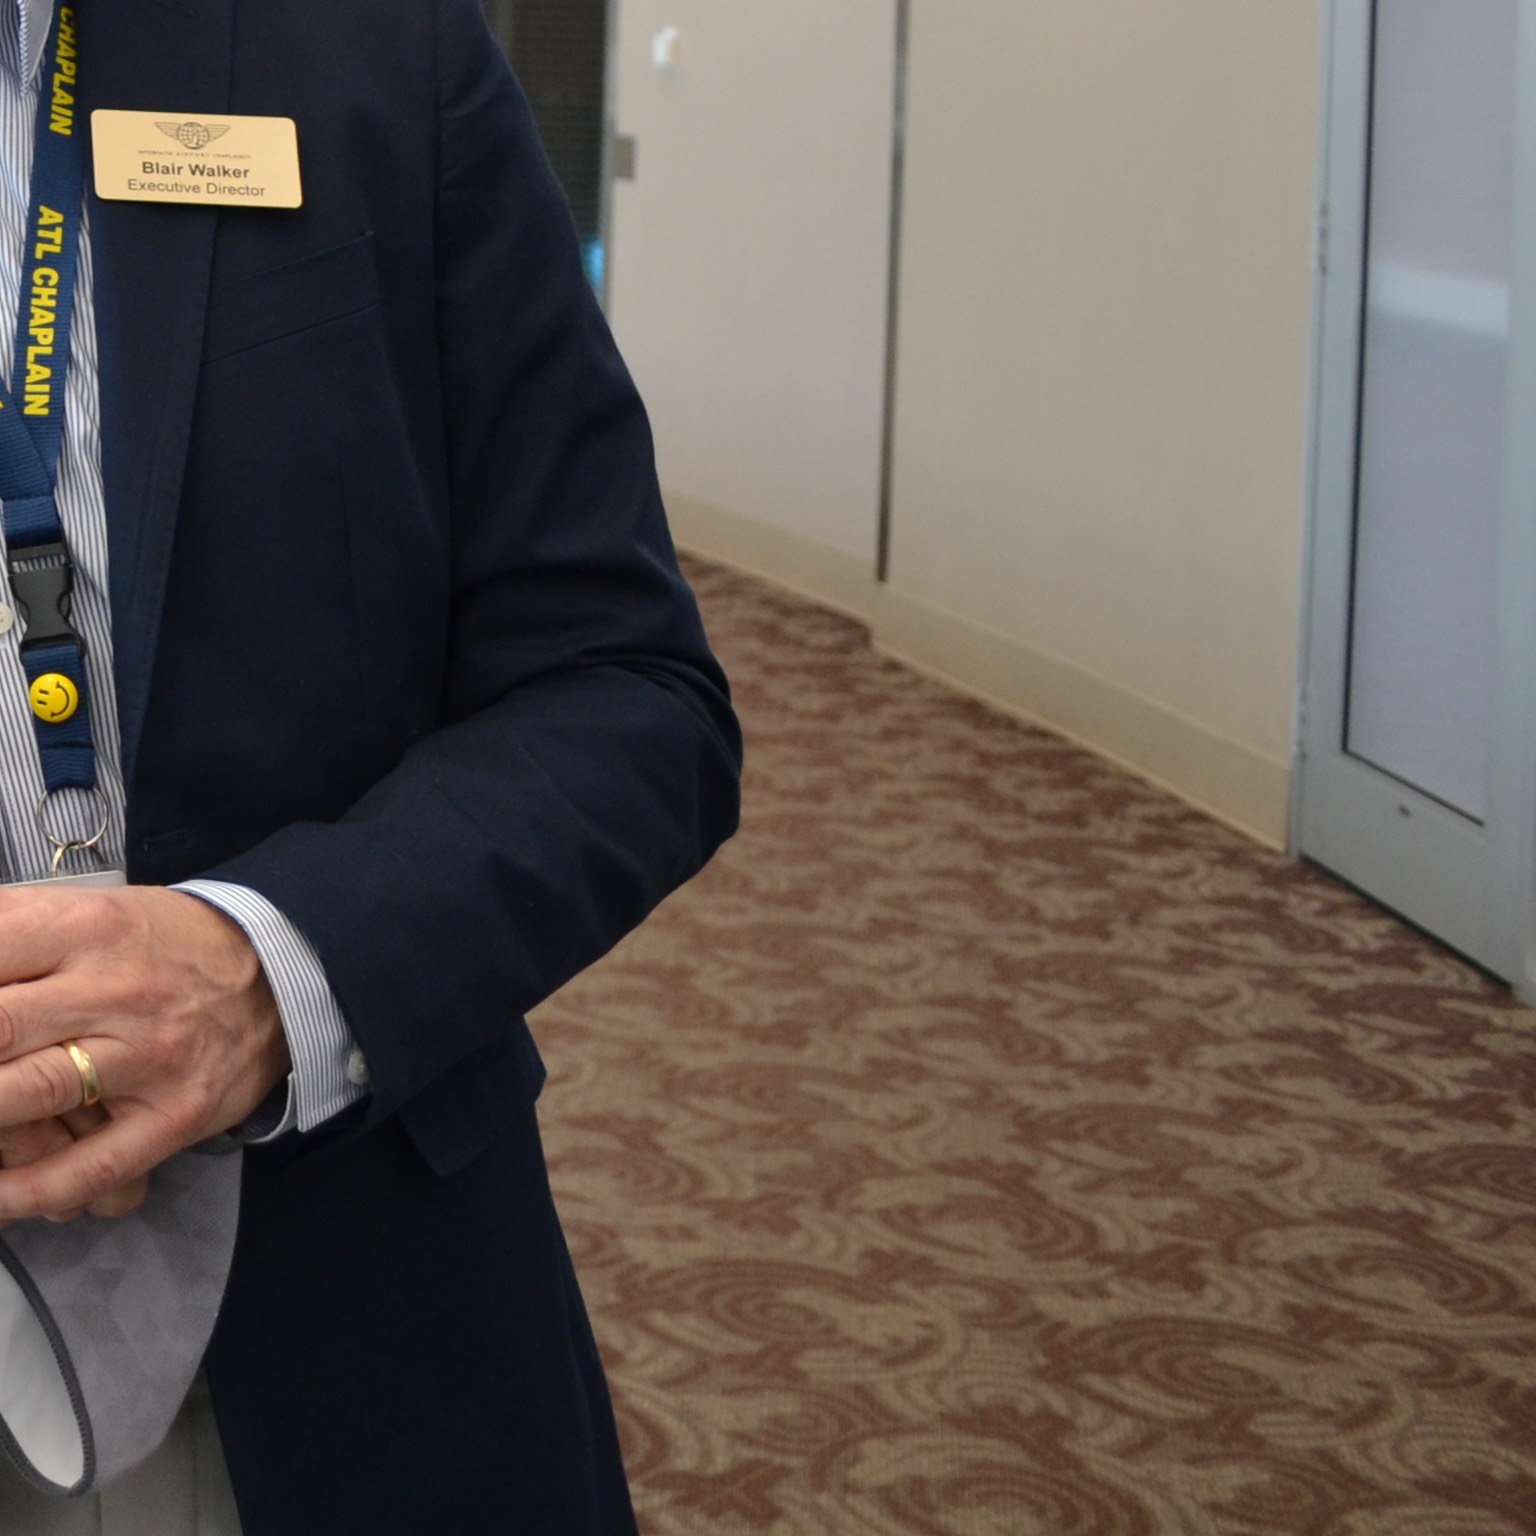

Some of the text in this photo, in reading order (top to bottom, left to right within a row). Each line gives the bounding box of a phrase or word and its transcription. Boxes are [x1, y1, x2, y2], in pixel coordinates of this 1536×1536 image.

[49, 7, 78, 136] CHAPLAIN
[127, 178, 266, 197] Executive Director
[141, 160, 251, 179] Blair Walker
[23, 204, 64, 416] ATL CHAPLAIN
